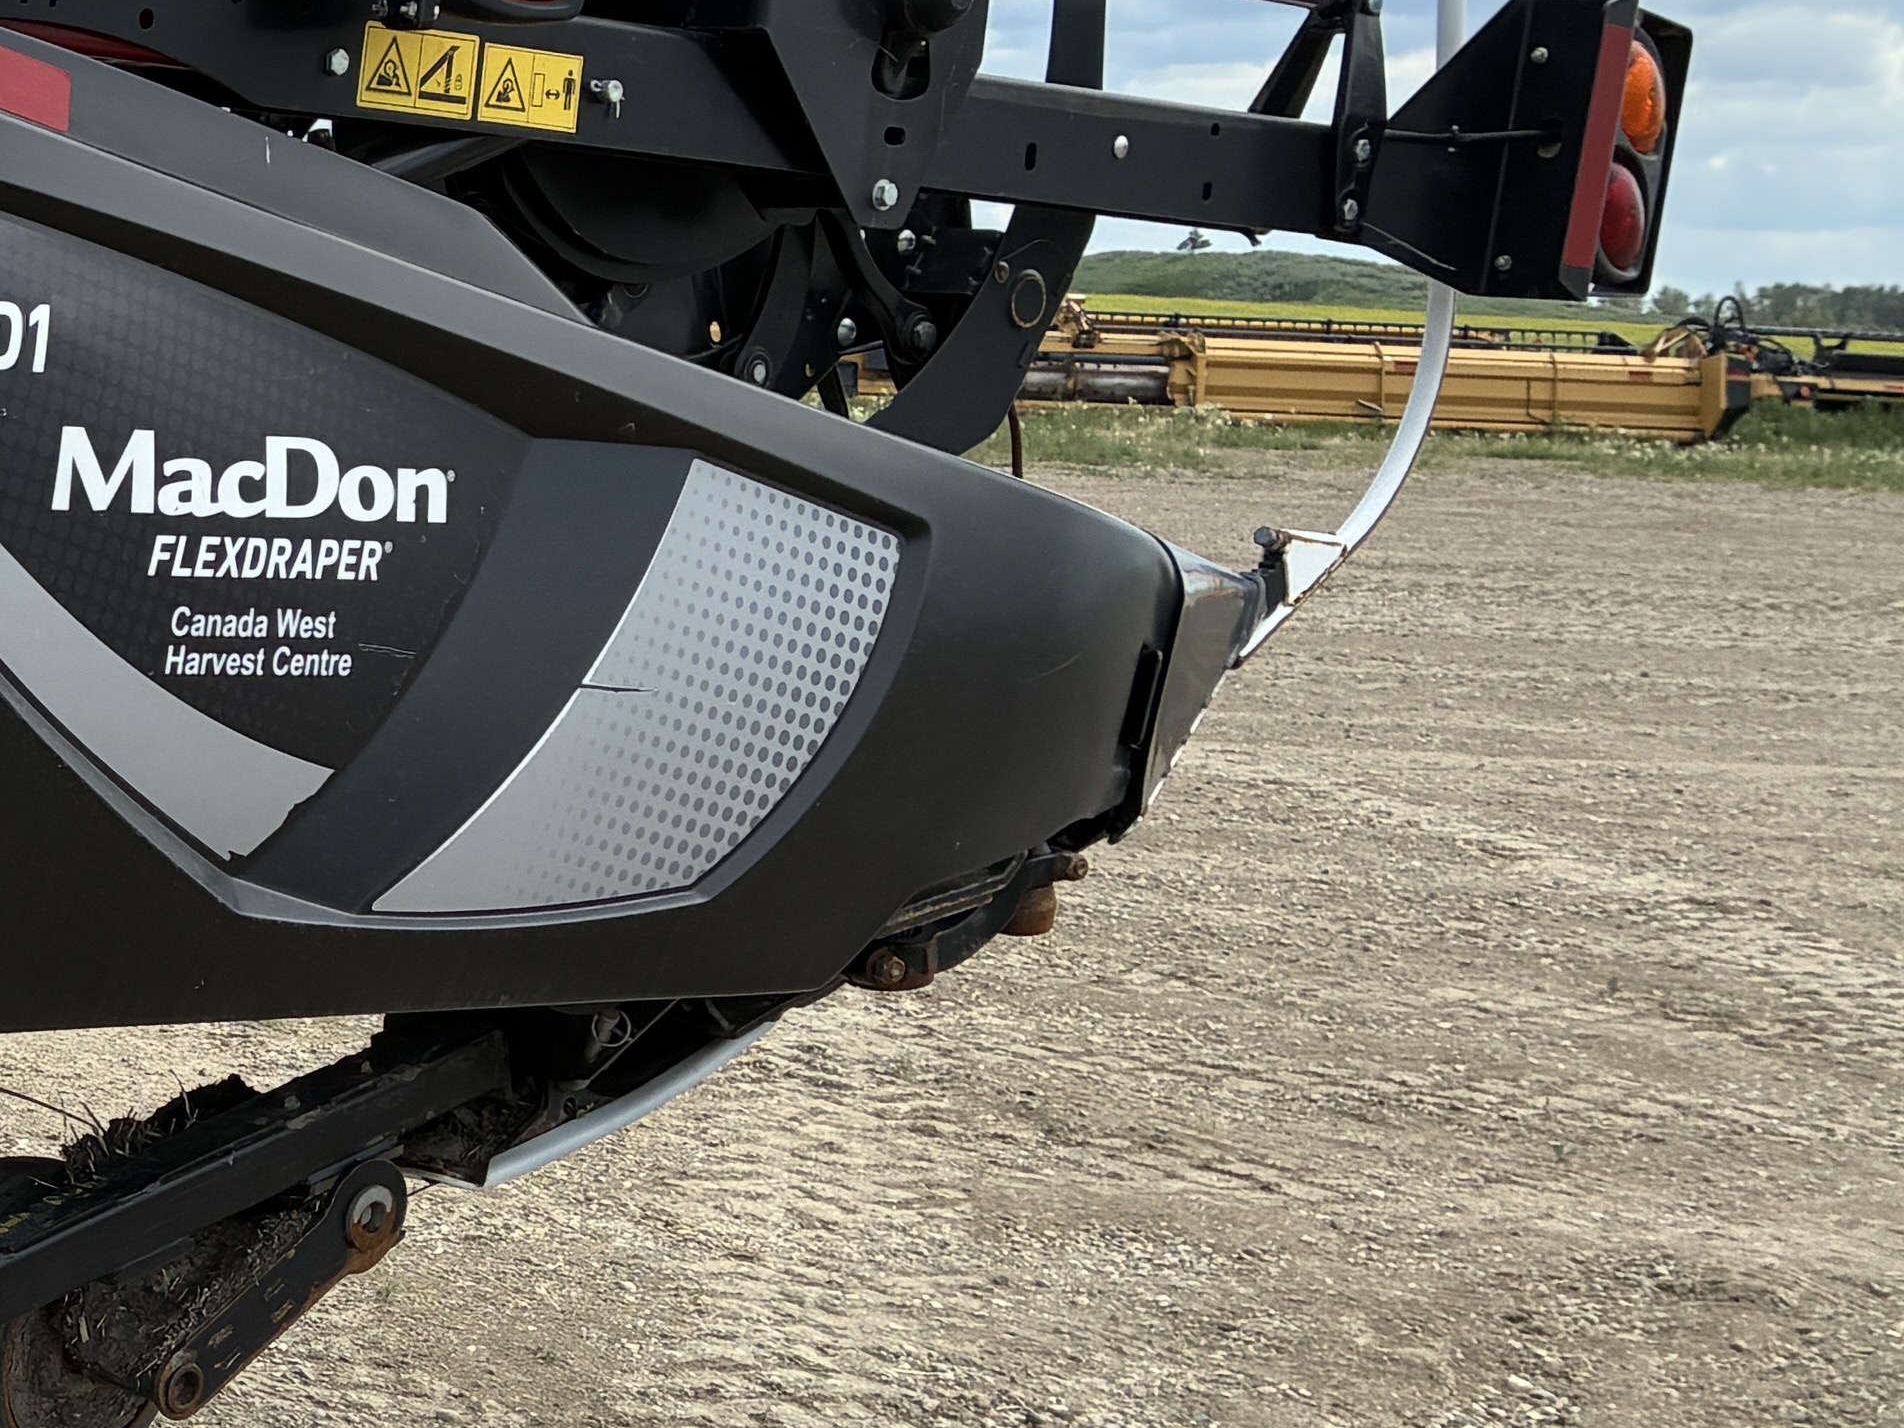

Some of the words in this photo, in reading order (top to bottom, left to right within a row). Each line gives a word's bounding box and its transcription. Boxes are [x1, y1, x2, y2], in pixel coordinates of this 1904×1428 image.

[50, 425, 449, 524] MacDon
[147, 534, 383, 581] FLEXDRAPER
[170, 606, 268, 639] Canada
[276, 607, 337, 639] West
[164, 645, 265, 676] Harvest
[273, 646, 353, 677] Centre
